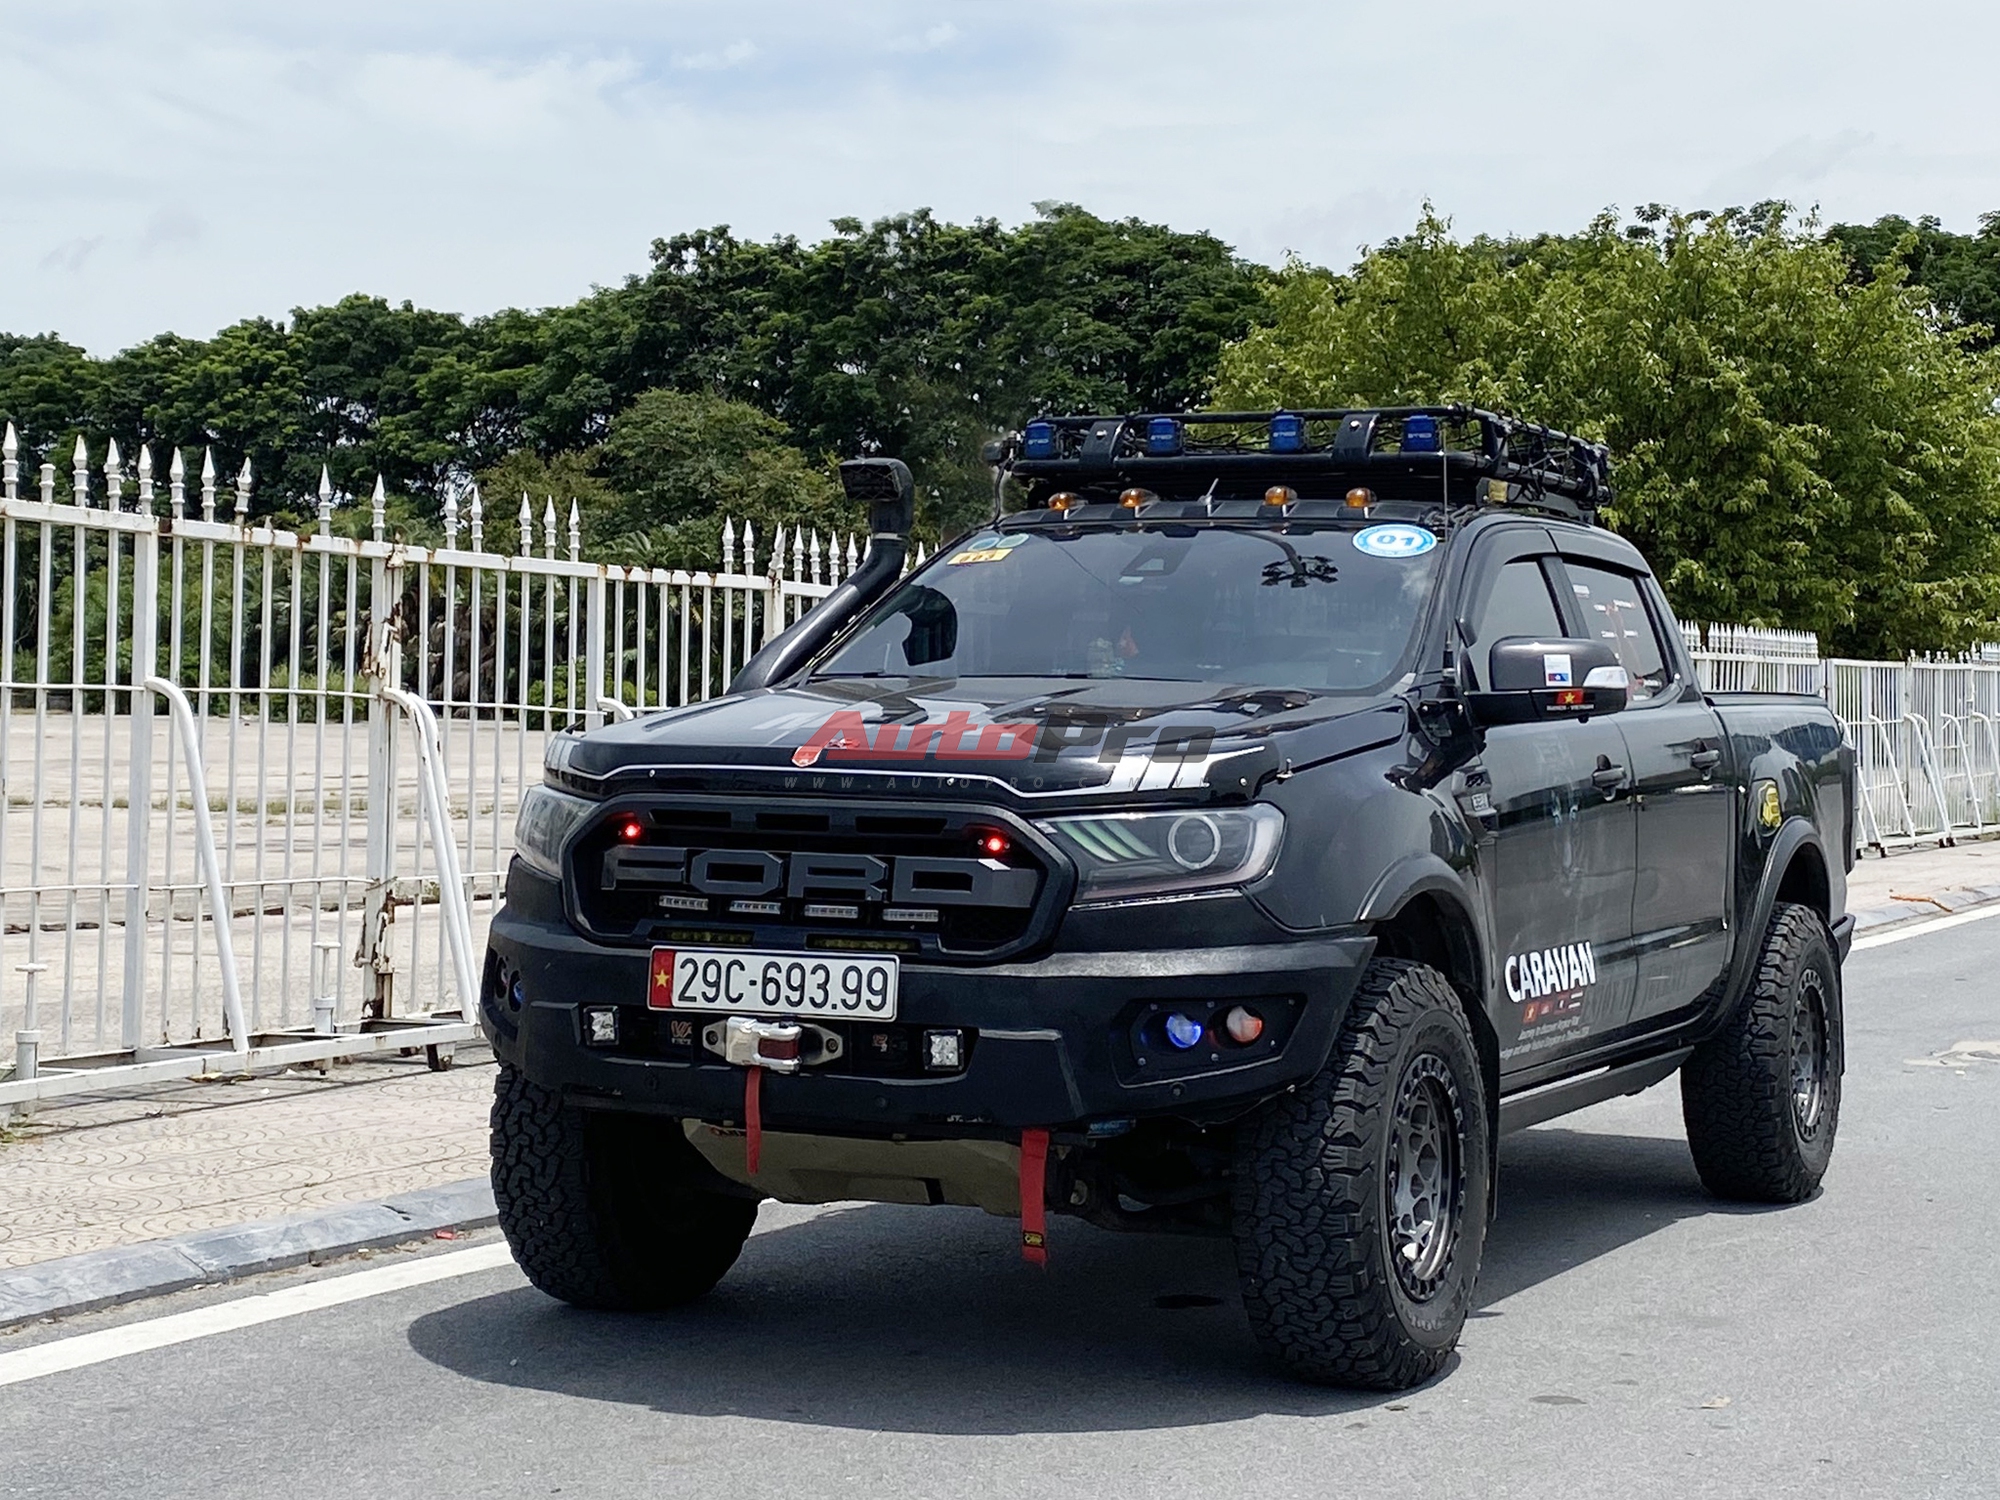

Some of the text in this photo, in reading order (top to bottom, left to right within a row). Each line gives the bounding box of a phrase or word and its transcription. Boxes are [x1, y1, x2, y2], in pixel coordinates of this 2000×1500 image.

[1377, 535, 1415, 547] 01
[601, 844, 1038, 908] FORD
[677, 957, 890, 1013] 29C-693.99
[1505, 941, 1597, 1003] CARAVAN
